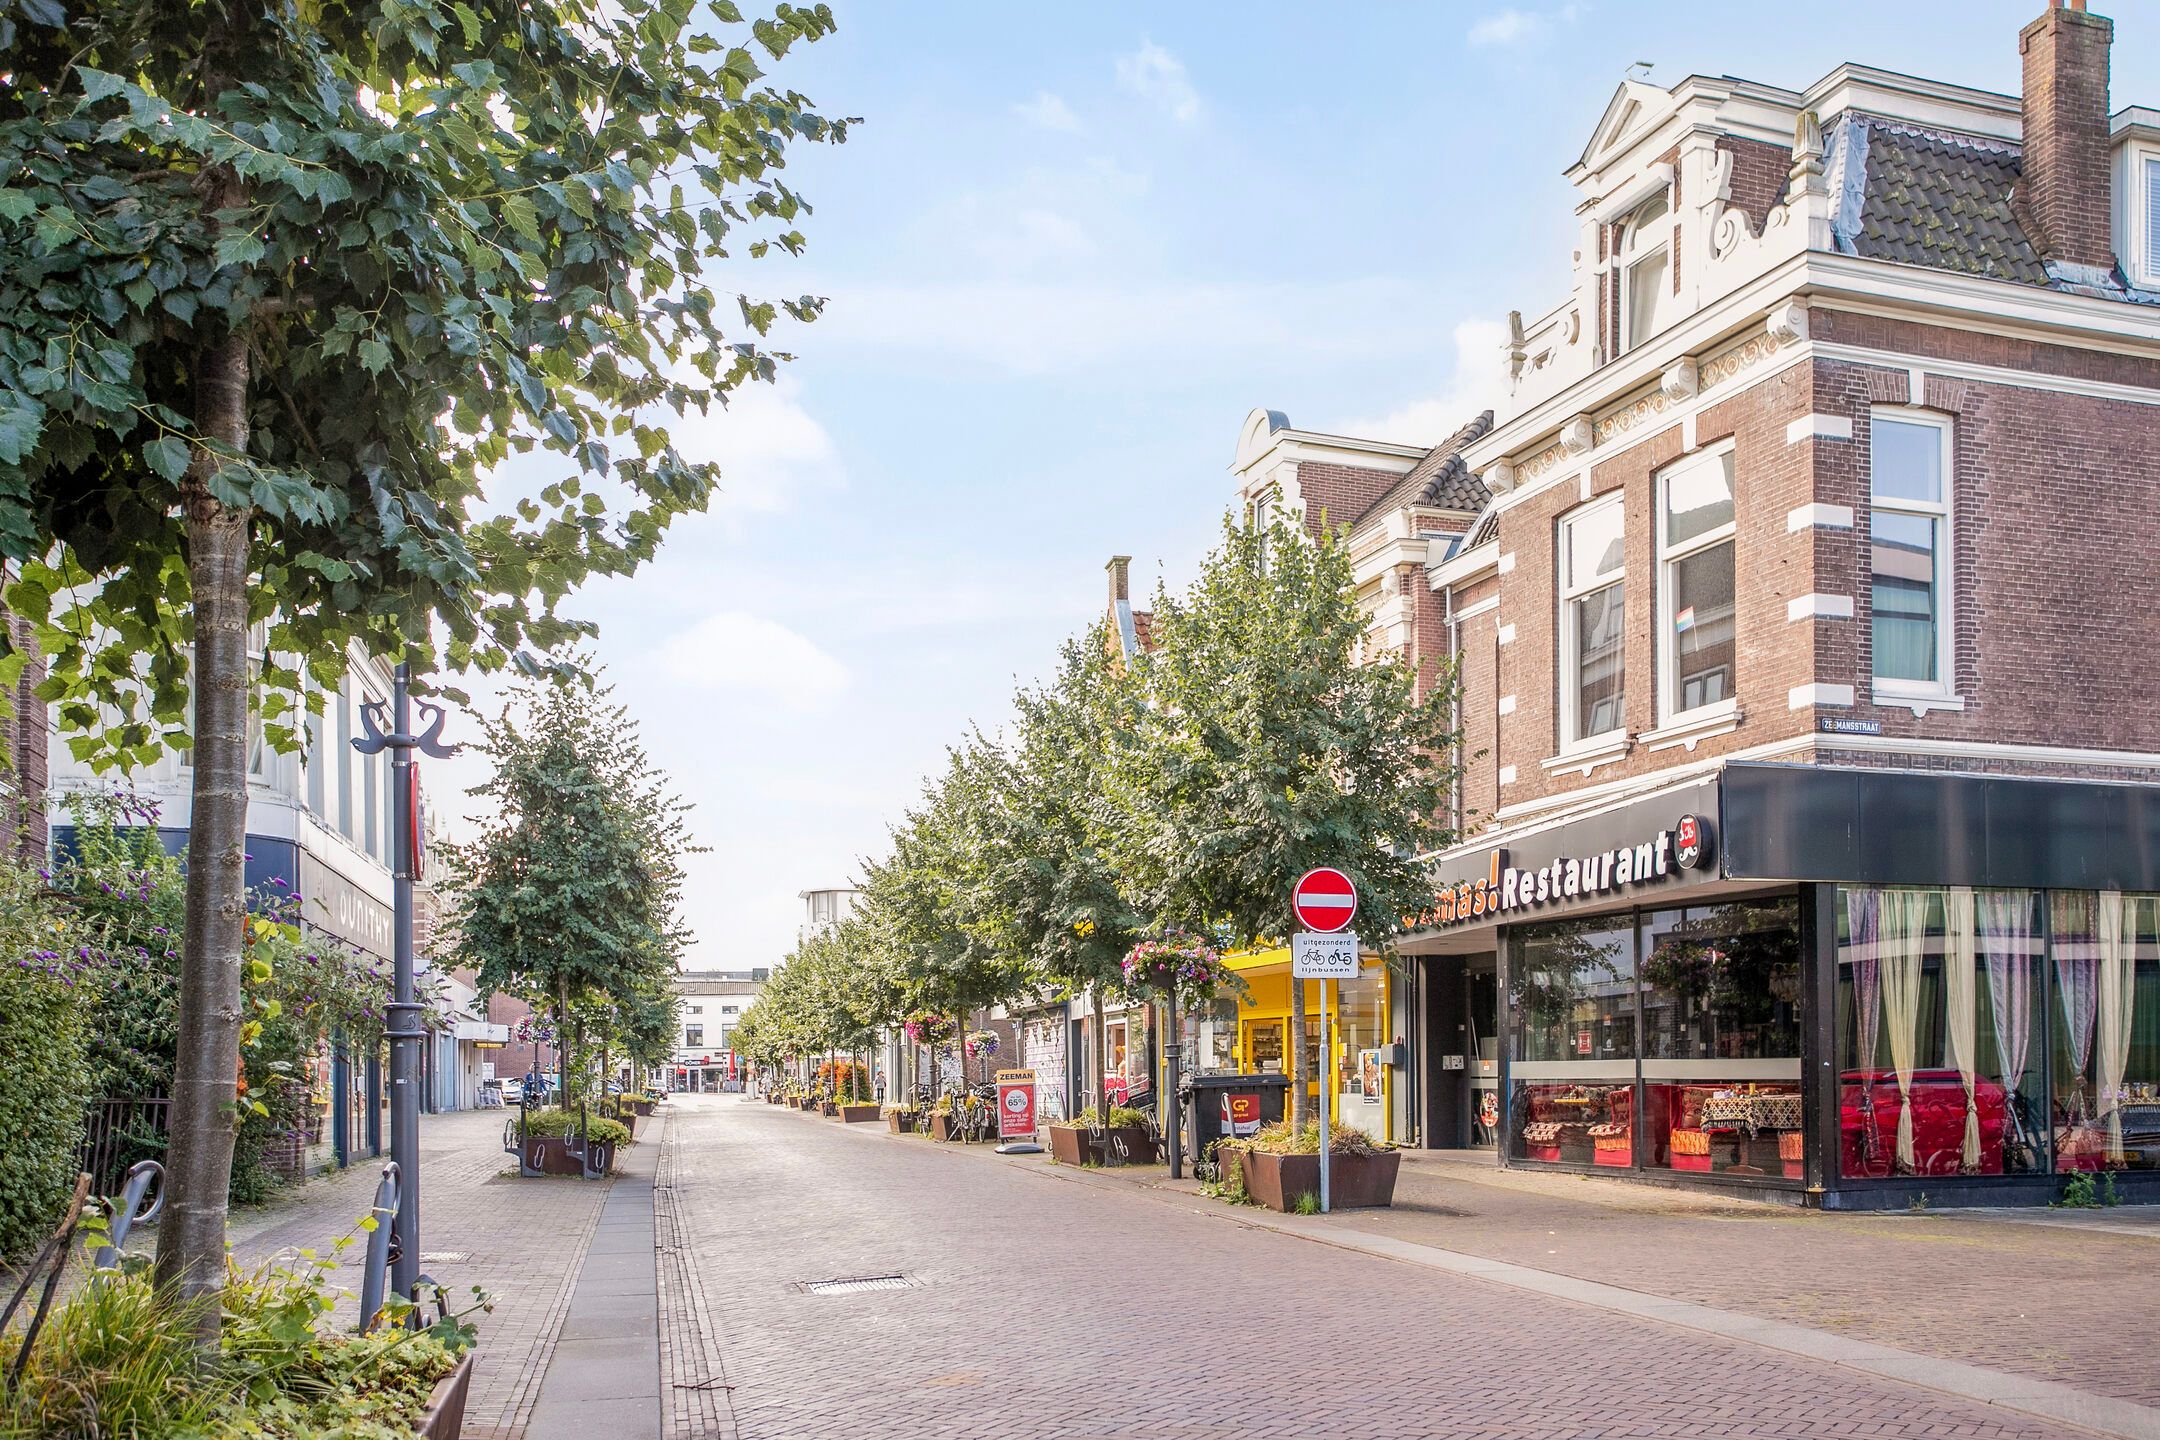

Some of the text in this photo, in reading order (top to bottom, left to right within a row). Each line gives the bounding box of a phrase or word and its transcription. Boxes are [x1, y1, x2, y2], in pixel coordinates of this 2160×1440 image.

[1825, 721, 1879, 732] ZEEMANSSTRAAT
[1502, 830, 1669, 910] Restaurant
[1303, 939, 1351, 947] uitgezonderd
[1008, 1098, 1026, 1107] 65%
